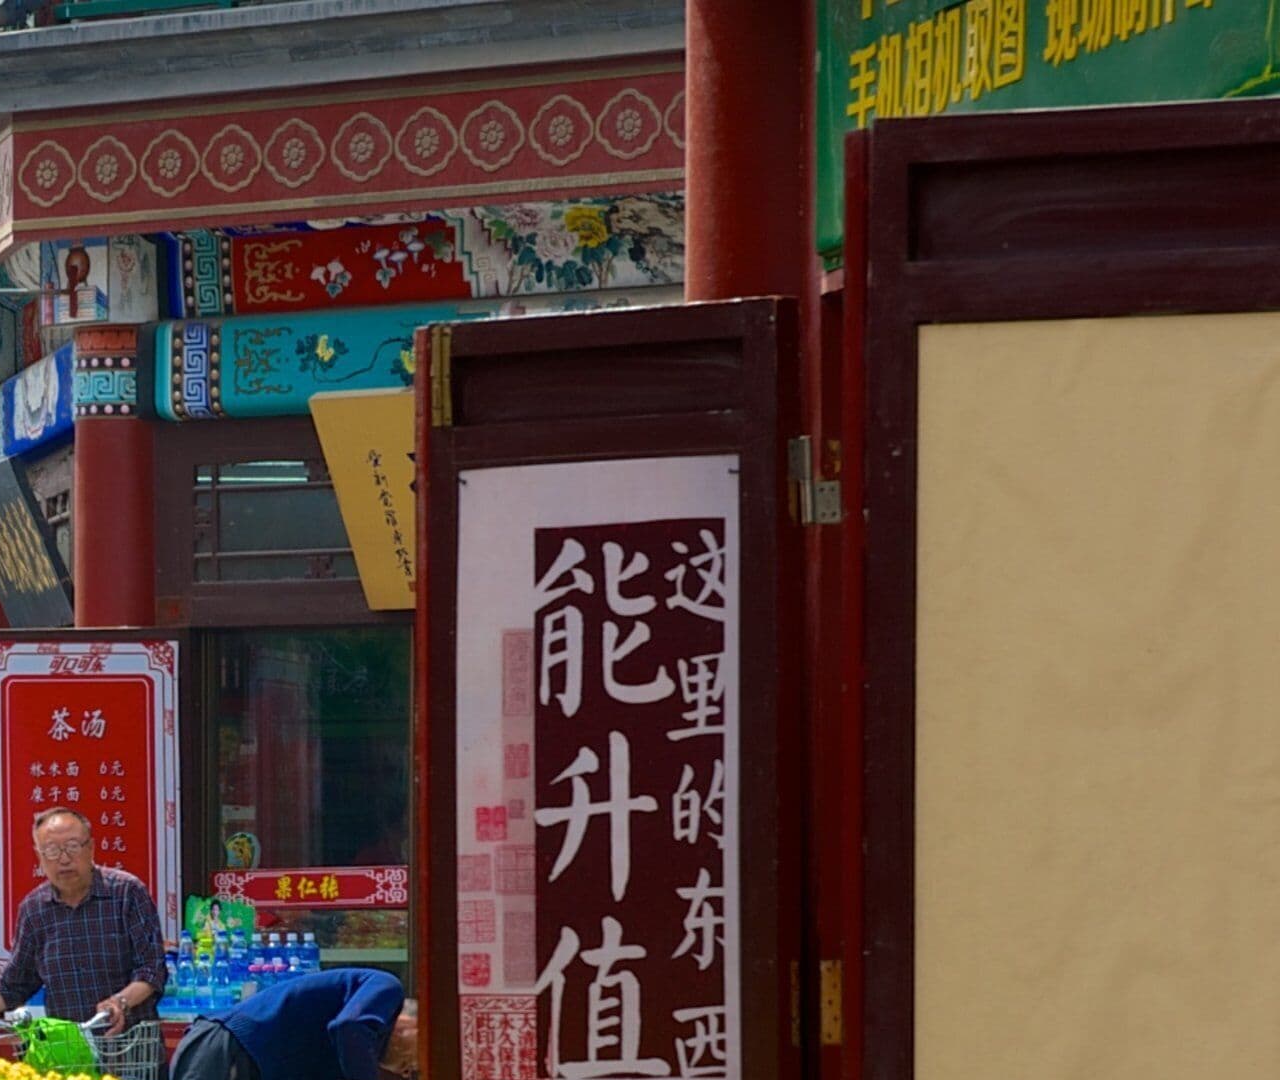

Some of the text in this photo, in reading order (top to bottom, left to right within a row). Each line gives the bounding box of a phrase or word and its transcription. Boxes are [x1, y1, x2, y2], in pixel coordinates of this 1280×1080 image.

[846, 0, 1026, 129] 手机相机取图
[49, 655, 108, 672] 可口可乐
[47, 708, 107, 740] 茶汤
[99, 760, 126, 777] 6元
[100, 785, 126, 802] 6元
[533, 537, 677, 1080] 能升值
[665, 527, 727, 1079] 这里的东西
[100, 811, 127, 827] 6元
[101, 836, 127, 852] 6元
